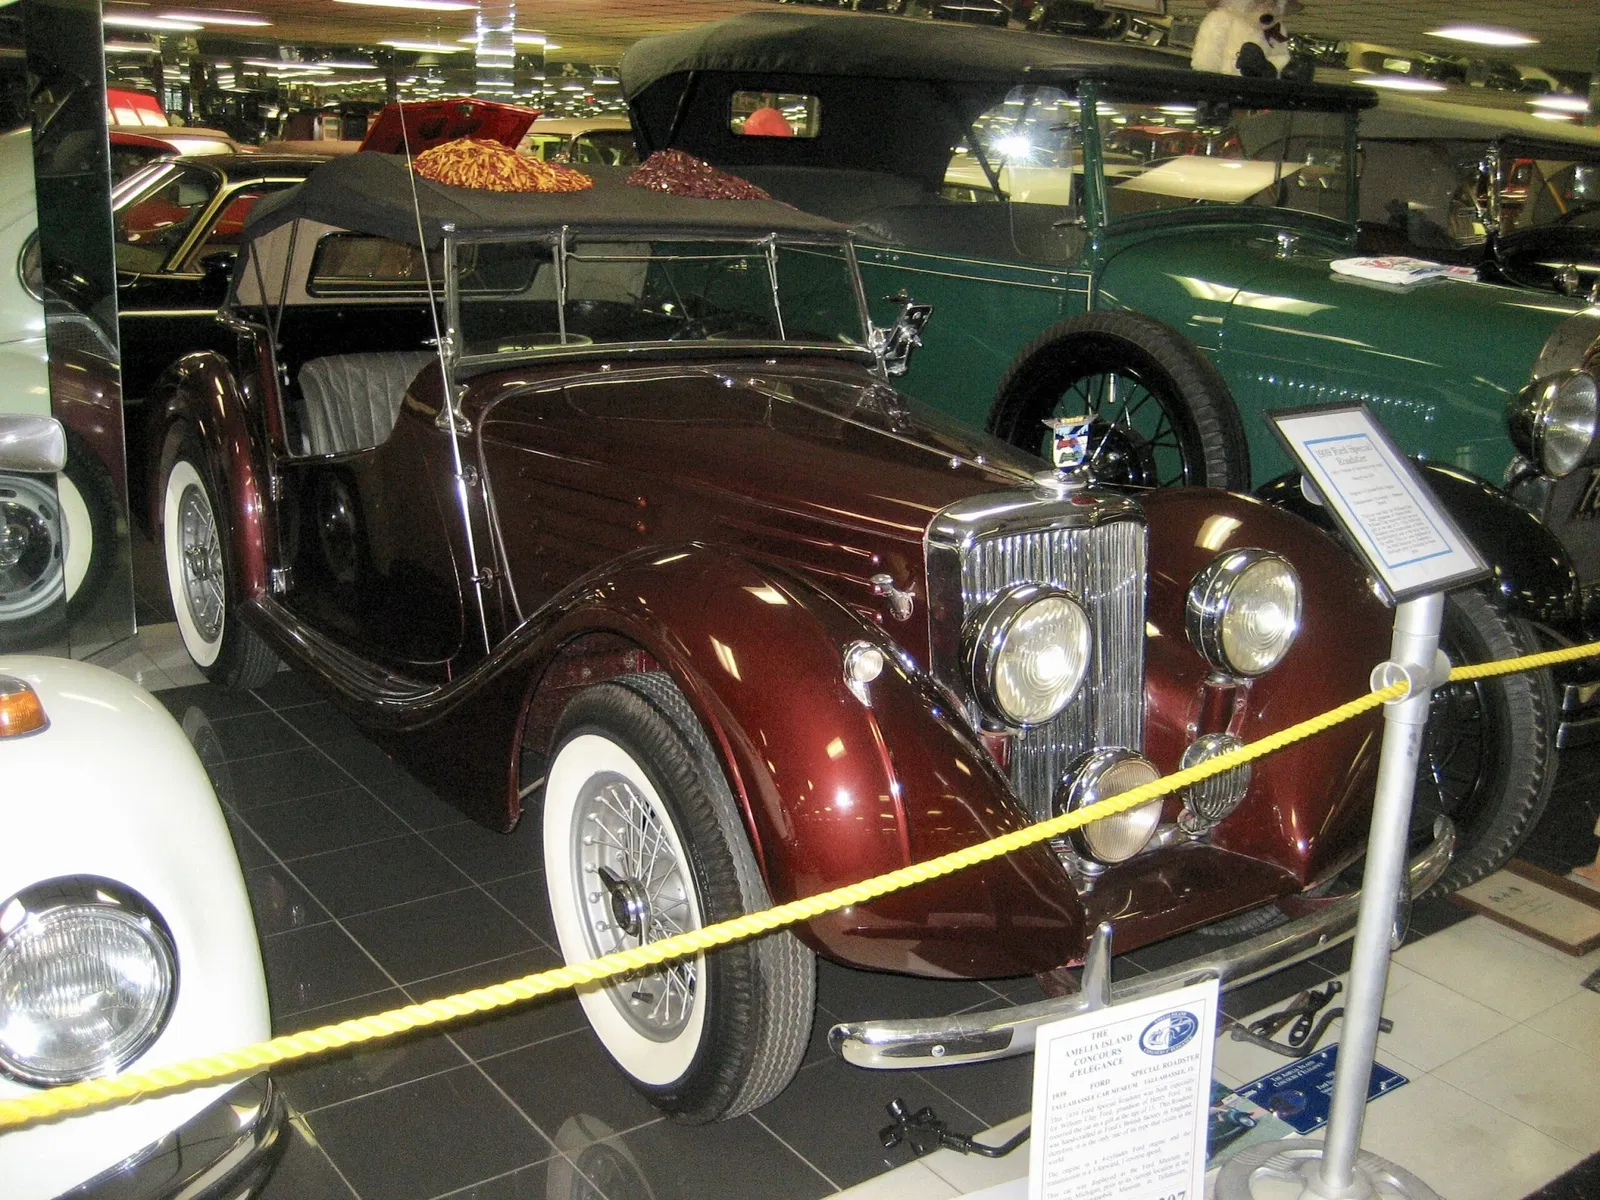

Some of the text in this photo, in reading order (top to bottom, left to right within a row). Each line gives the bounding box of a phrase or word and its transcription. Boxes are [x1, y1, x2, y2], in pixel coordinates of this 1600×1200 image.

[1091, 1028, 1108, 1040] THE
[1065, 1034, 1132, 1058] AMELIA ISLAND
[1069, 1058, 1124, 1077] d'ELEGANCE
[1074, 1048, 1122, 1066] CONCOURS
[1052, 1054, 1199, 1099] 1939 FORD SPECIAL ROADSTER
[1051, 1096, 1094, 1110] TALLAHASSEE
[1111, 1083, 1137, 1094] MUSEUM
